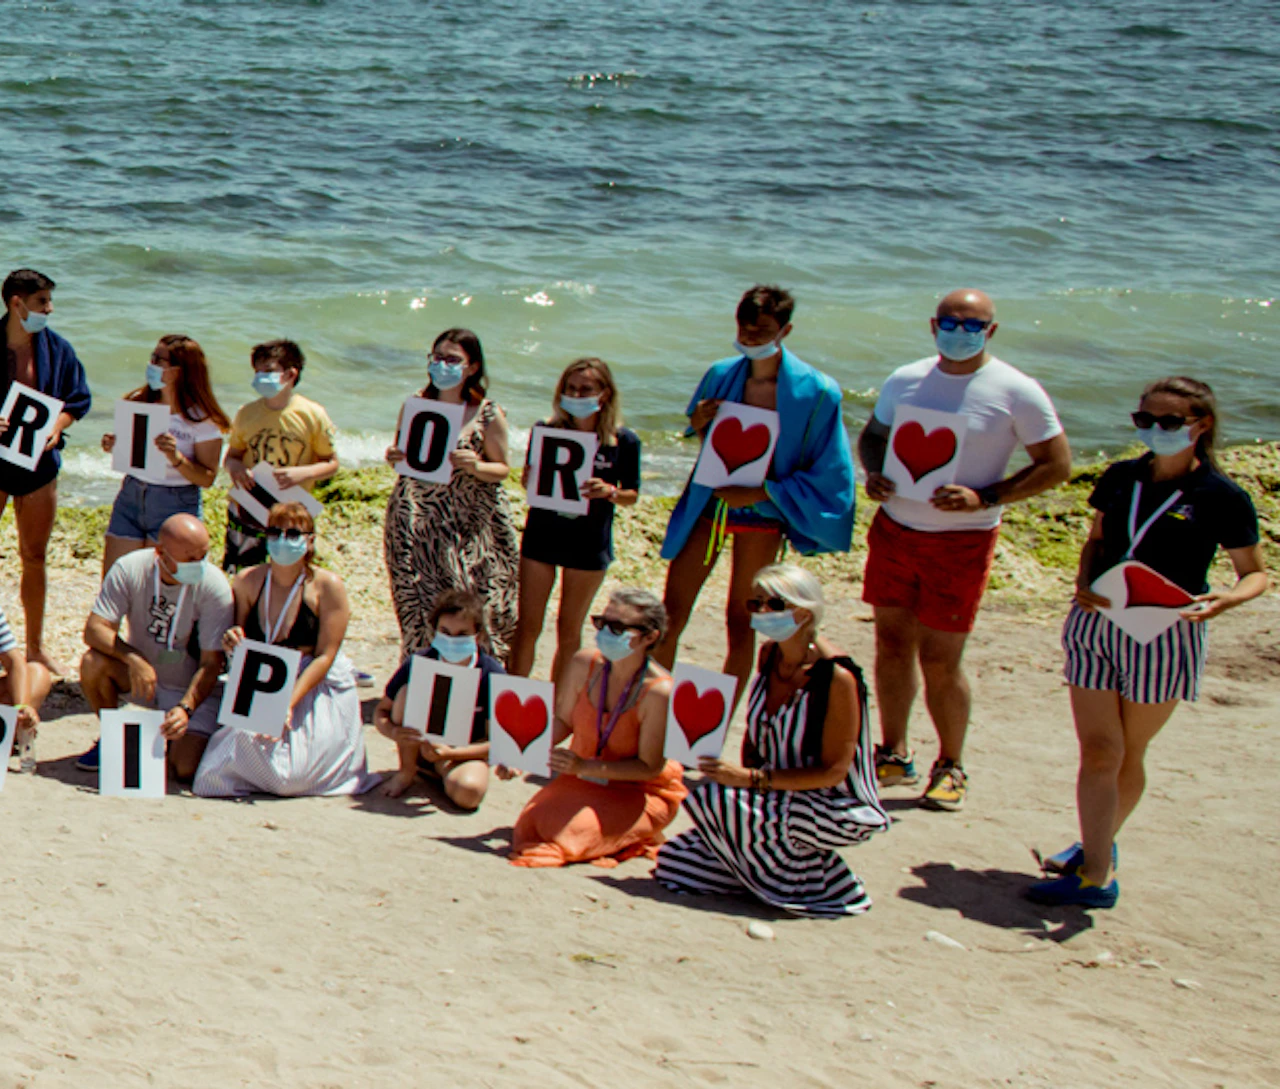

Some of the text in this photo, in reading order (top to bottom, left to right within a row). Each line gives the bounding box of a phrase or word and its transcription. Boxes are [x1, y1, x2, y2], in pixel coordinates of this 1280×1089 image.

[406, 411, 450, 473] O
[536, 436, 588, 502] R
[232, 649, 287, 717] P
